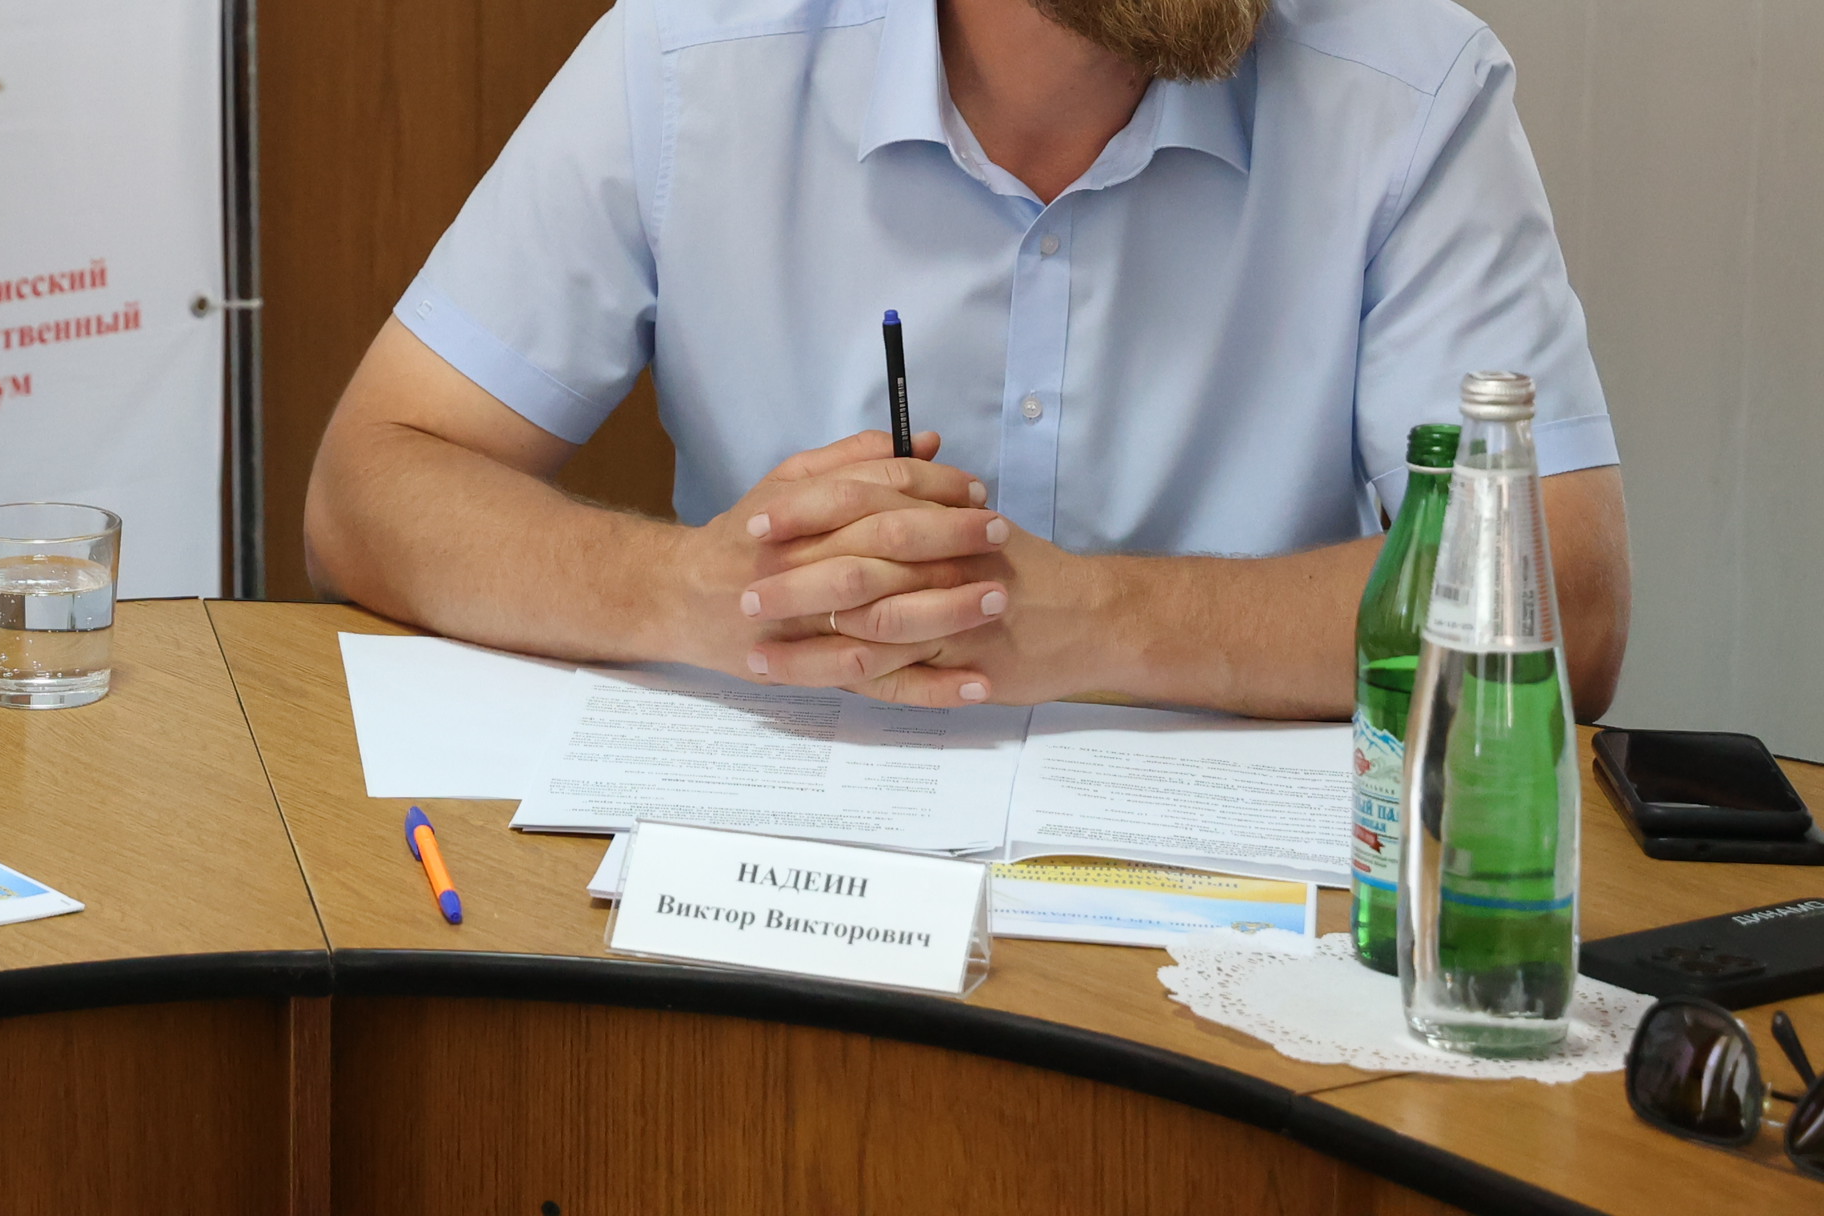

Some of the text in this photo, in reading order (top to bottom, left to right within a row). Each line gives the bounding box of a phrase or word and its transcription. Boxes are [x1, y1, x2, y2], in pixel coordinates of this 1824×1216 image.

[737, 862, 870, 898] НАДЕИН
[655, 894, 932, 948] Виктор Викторович
